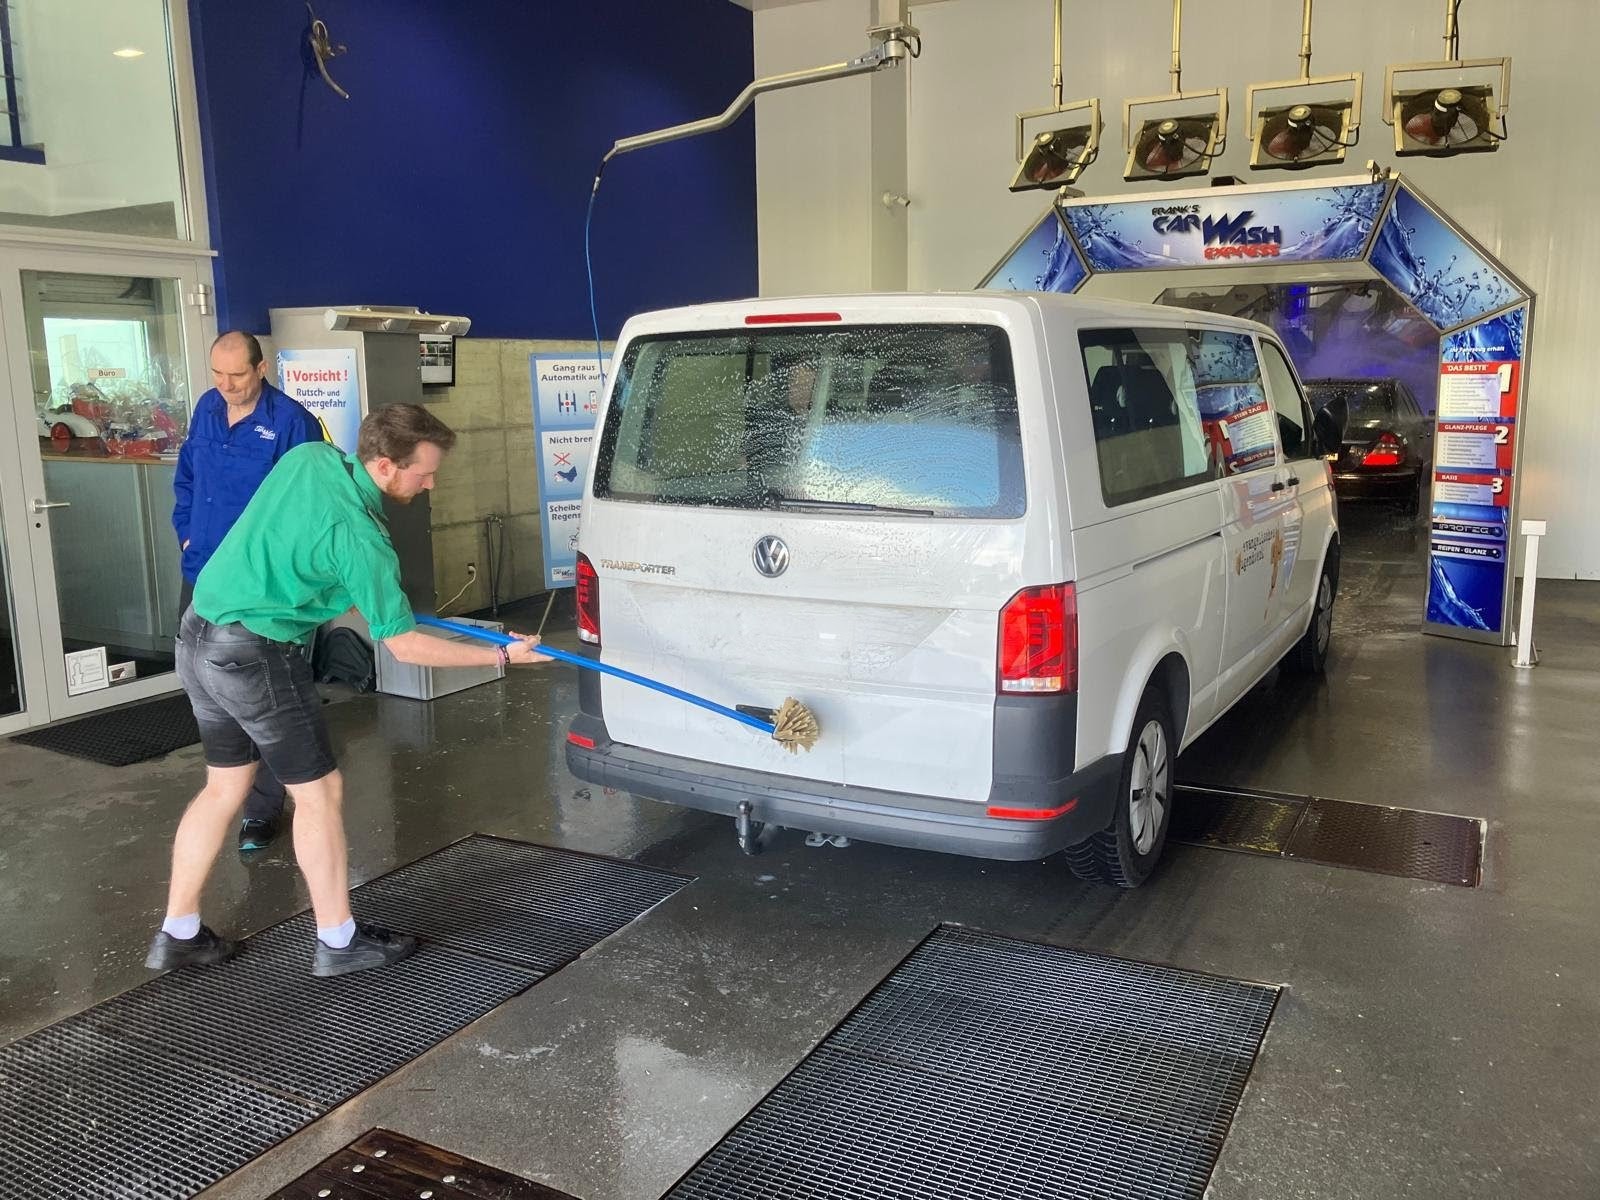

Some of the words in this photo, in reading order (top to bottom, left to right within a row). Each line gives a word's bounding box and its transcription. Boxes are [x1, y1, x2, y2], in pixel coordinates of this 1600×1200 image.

[552, 364, 576, 373] Gang
[286, 370, 290, 382] !
[293, 369, 341, 382] Vorsicht
[344, 369, 348, 381] !
[541, 373, 587, 382] Automatik
[1497, 363, 1512, 392] 1
[296, 387, 326, 397] Rutsch-
[327, 389, 340, 397] und
[549, 436, 573, 444] Nicht
[1493, 425, 1509, 444] 2
[1491, 477, 1503, 493] 3
[1437, 544, 1460, 553] REIFEN
[1464, 547, 1487, 555] GLANZ
[600, 558, 676, 575] TRANSPORTER
